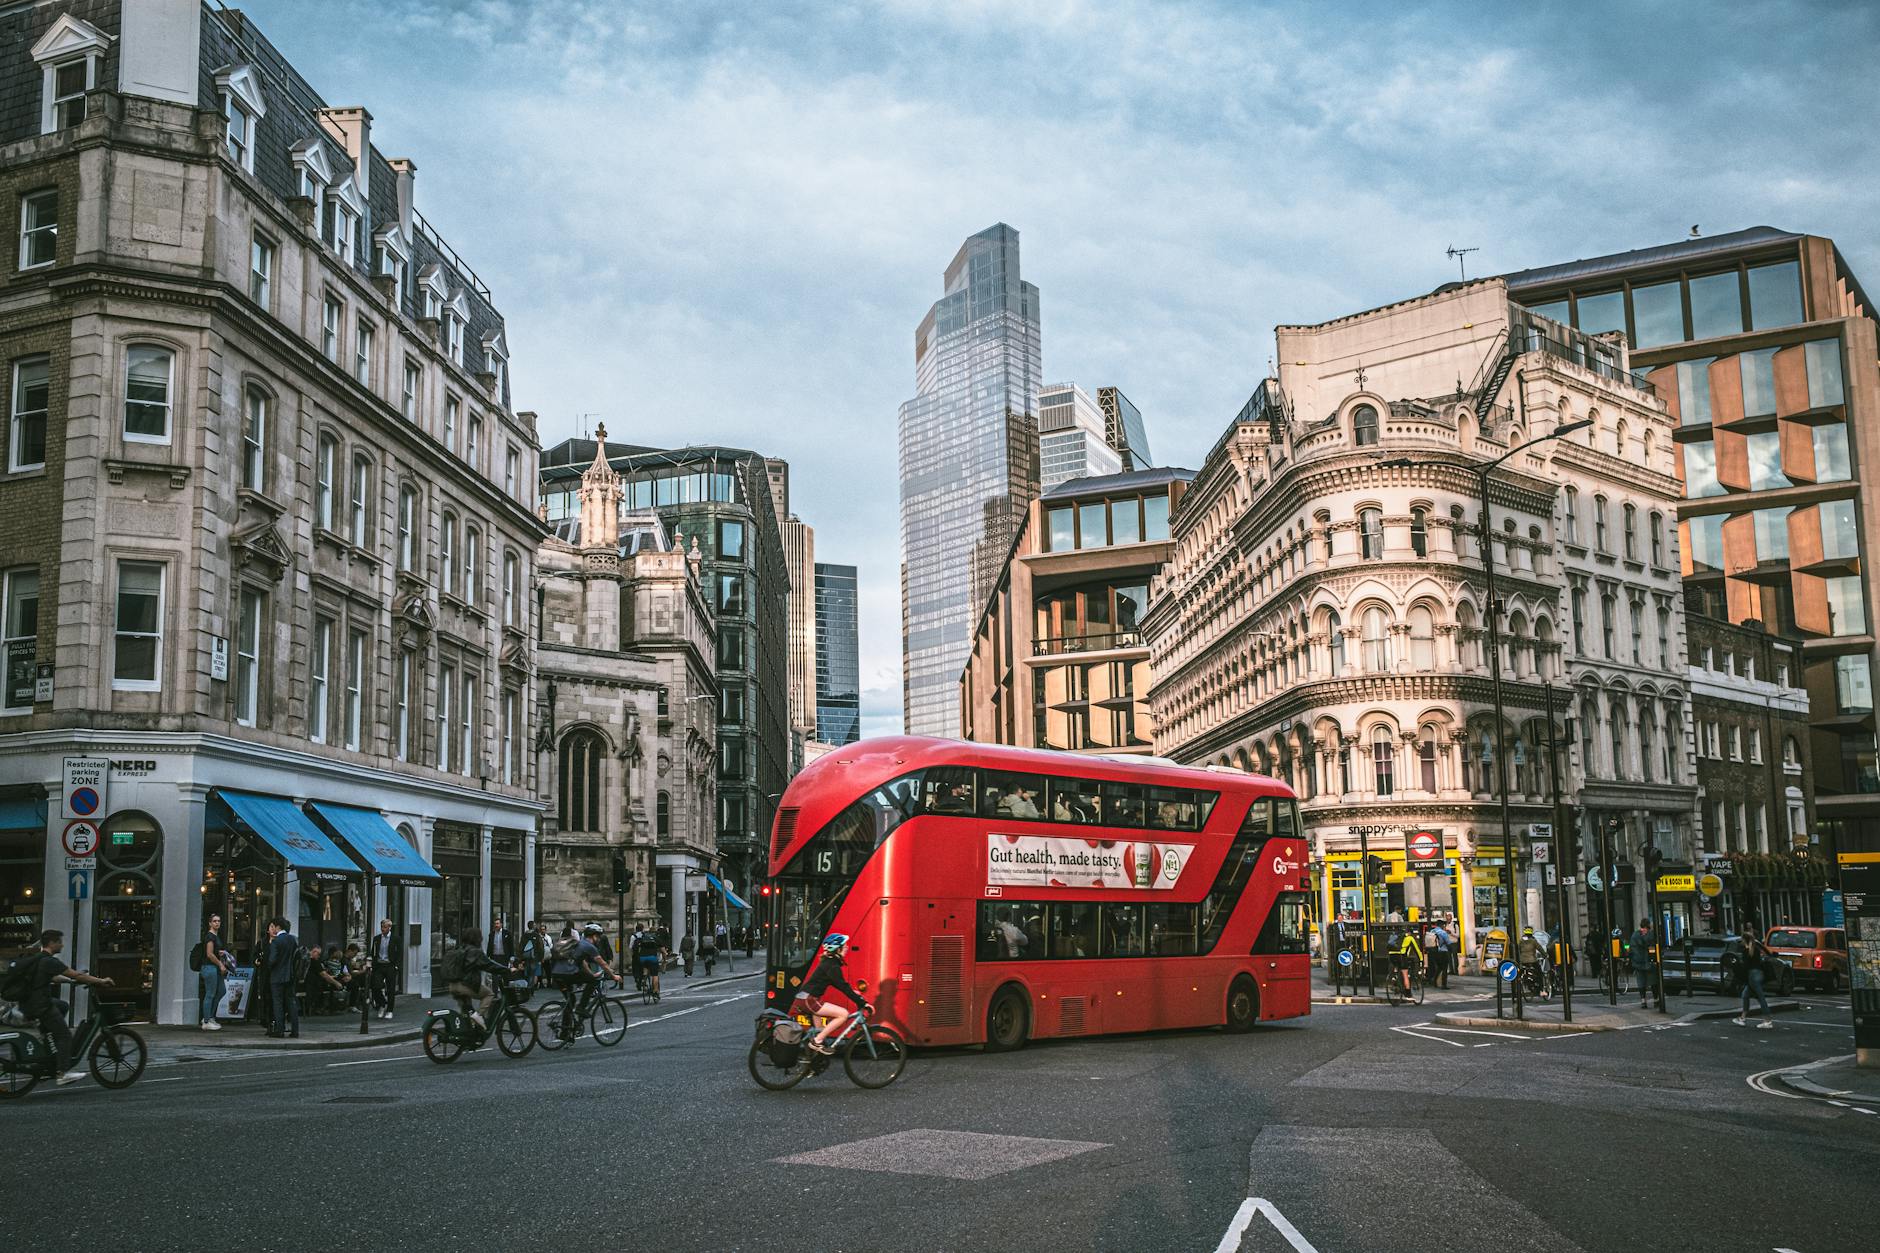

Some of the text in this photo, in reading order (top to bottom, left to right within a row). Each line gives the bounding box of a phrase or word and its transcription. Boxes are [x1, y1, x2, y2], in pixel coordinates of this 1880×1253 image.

[66, 760, 106, 768] Restricted
[109, 760, 156, 771] NERO
[71, 768, 100, 777] parking
[71, 777, 99, 785] ZONE
[283, 838, 325, 851] NERO
[817, 851, 833, 873] 15
[990, 847, 1013, 863] Gut
[1015, 848, 1057, 866] health,
[1059, 851, 1090, 866] made
[1092, 854, 1122, 869] tasty.
[1273, 856, 1287, 875] Go
